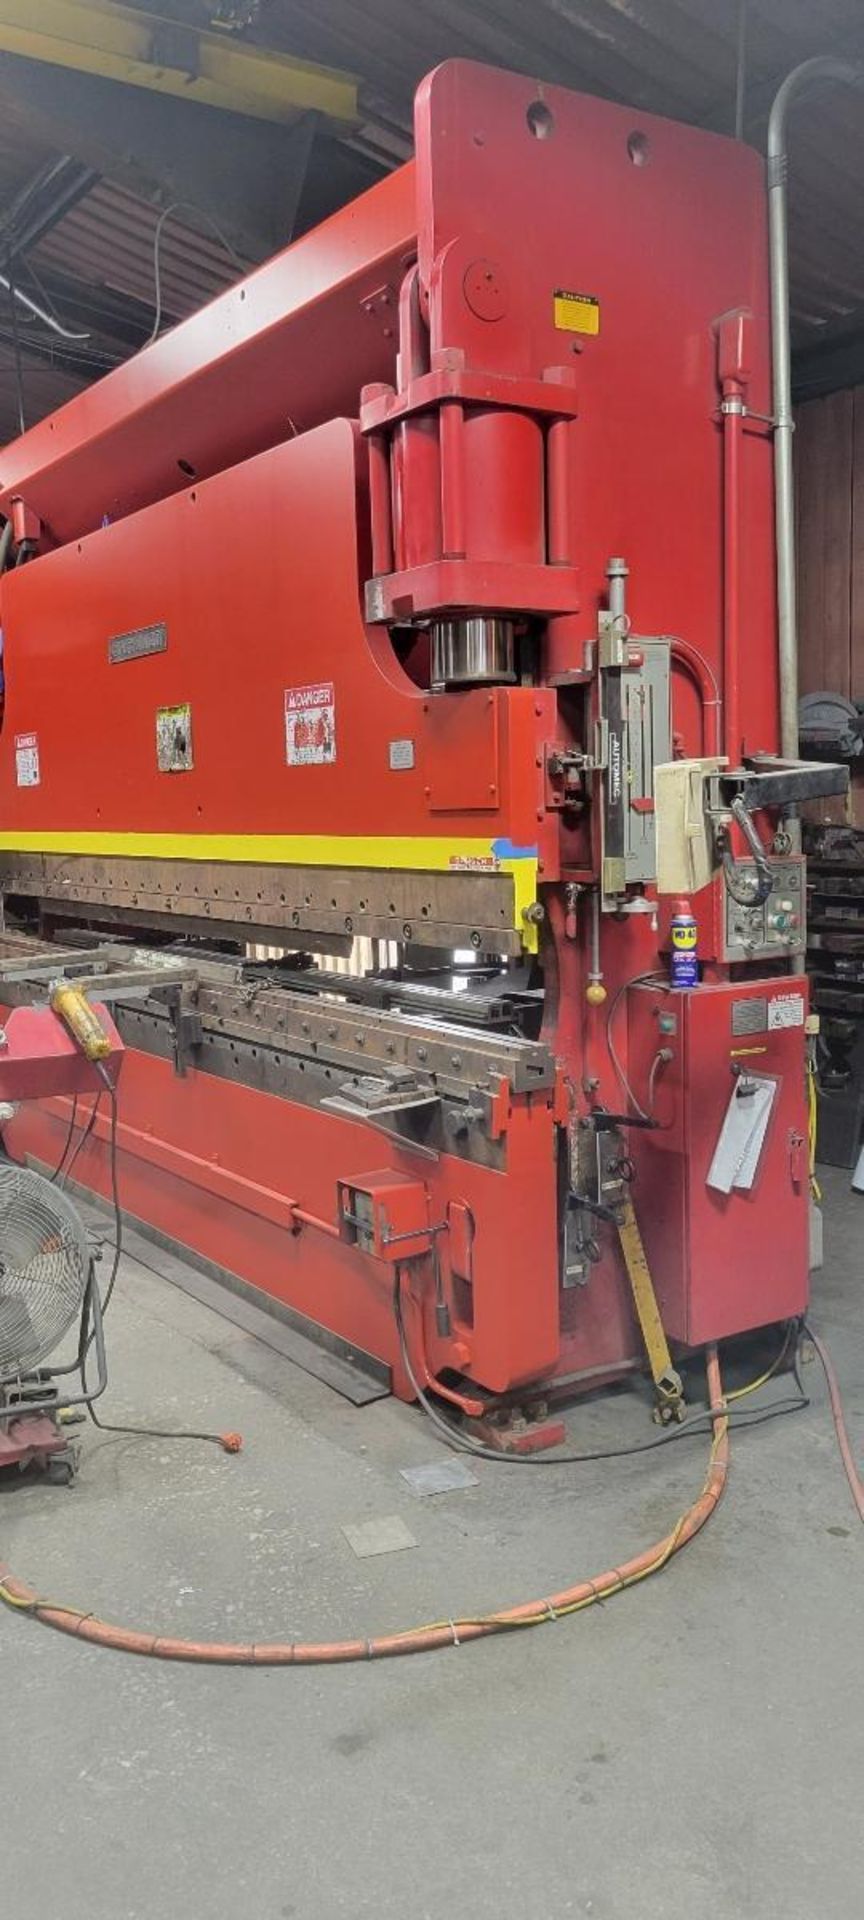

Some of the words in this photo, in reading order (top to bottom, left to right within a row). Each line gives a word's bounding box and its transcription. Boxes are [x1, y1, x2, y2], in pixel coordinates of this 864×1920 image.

[298, 690, 330, 706] DANGER
[612, 740, 621, 797] AUTOMEC
[673, 927, 697, 940] WD40
